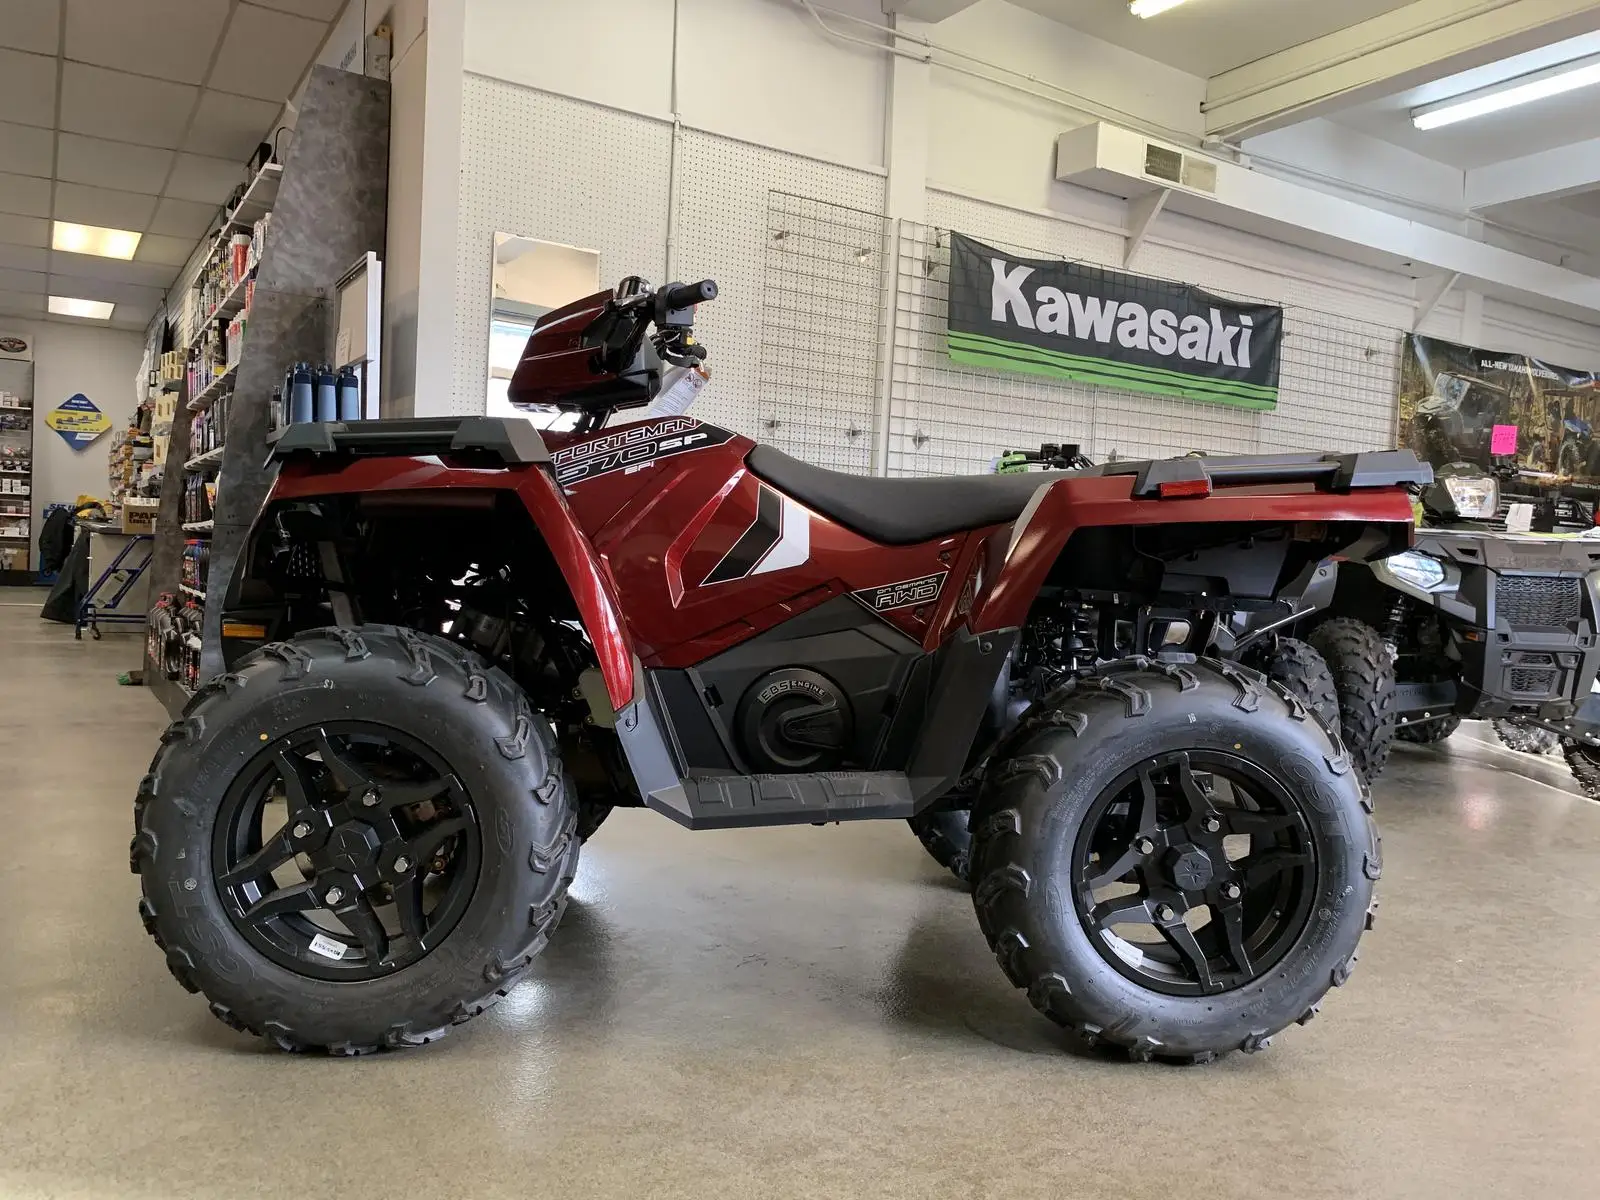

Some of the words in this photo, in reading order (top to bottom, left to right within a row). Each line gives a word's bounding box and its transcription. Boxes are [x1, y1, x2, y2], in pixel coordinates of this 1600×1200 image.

[990, 258, 1253, 369] Kawasaki
[550, 418, 697, 464] PORTSMAN
[556, 441, 658, 484] 570
[659, 433, 708, 451] SP
[875, 583, 938, 608] AWD
[876, 587, 891, 595] ON
[895, 577, 937, 591] DEMAND
[760, 680, 789, 703] EBS
[791, 680, 825, 697] ENGINE
